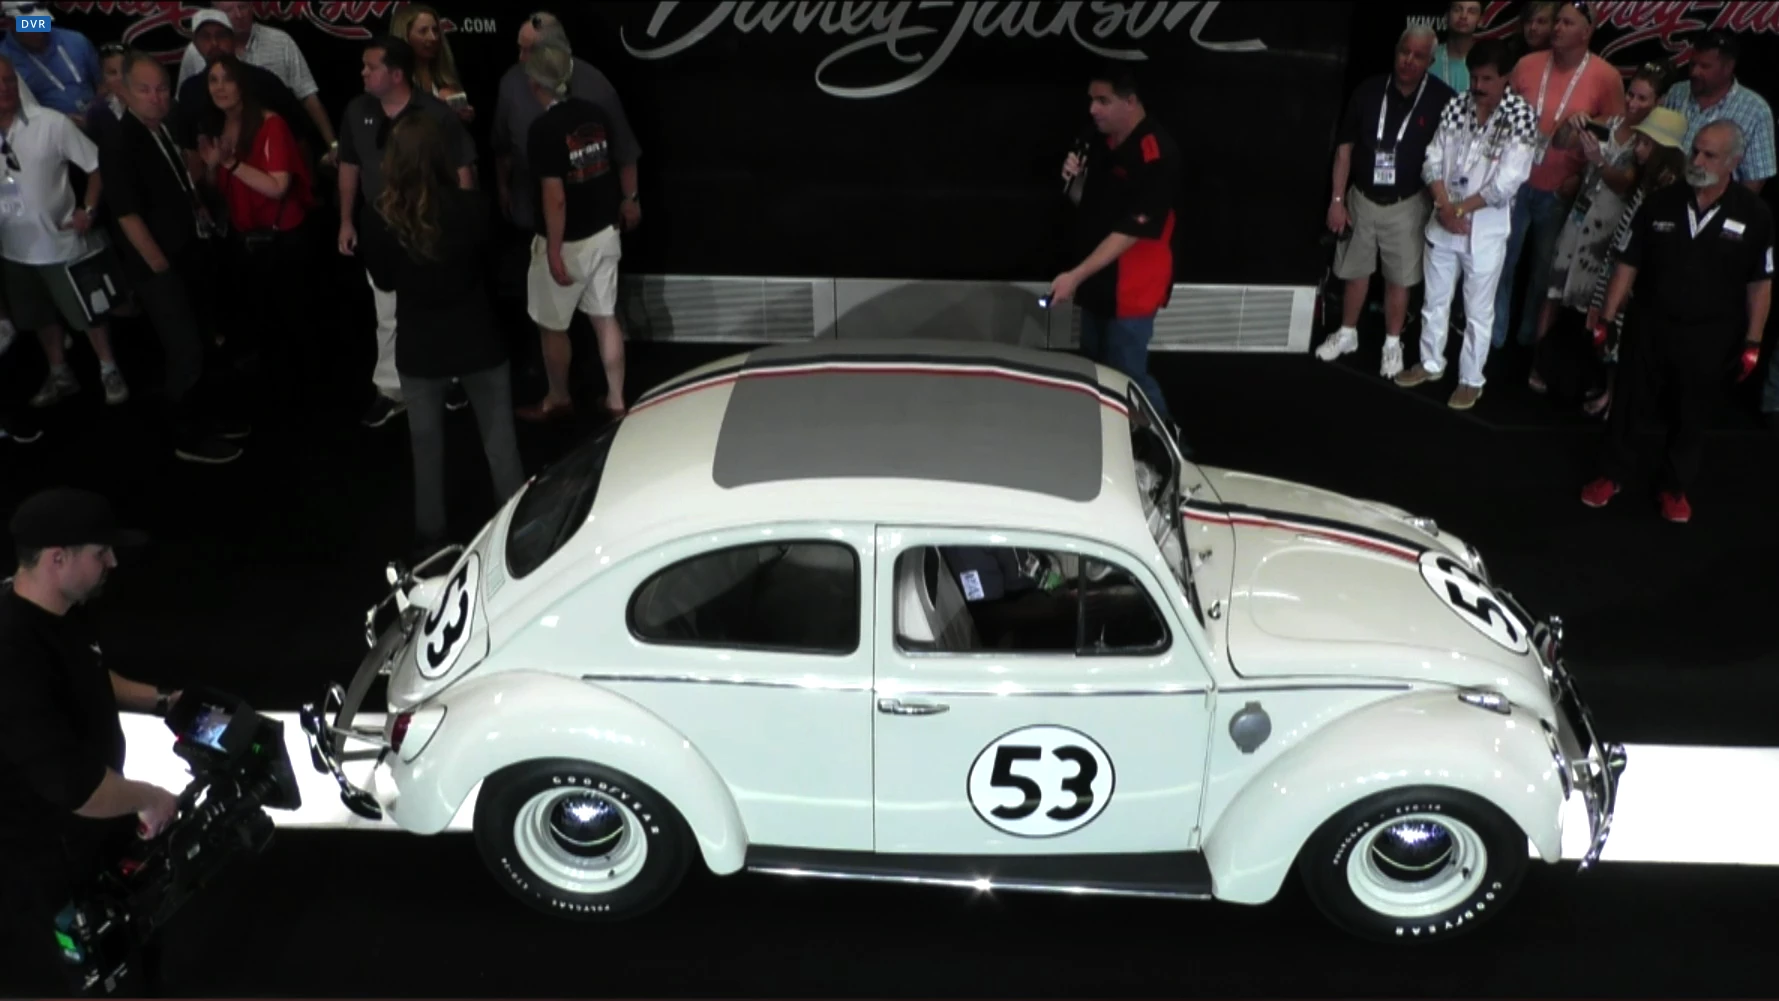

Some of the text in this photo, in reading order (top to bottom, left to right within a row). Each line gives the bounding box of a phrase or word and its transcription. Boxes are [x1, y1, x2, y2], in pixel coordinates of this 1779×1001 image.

[424, 559, 469, 669] 53
[1436, 556, 1518, 643] 53
[552, 775, 660, 835] GOODYEAR
[989, 744, 1099, 822] 53
[1394, 880, 1503, 936] GOODYEAR
